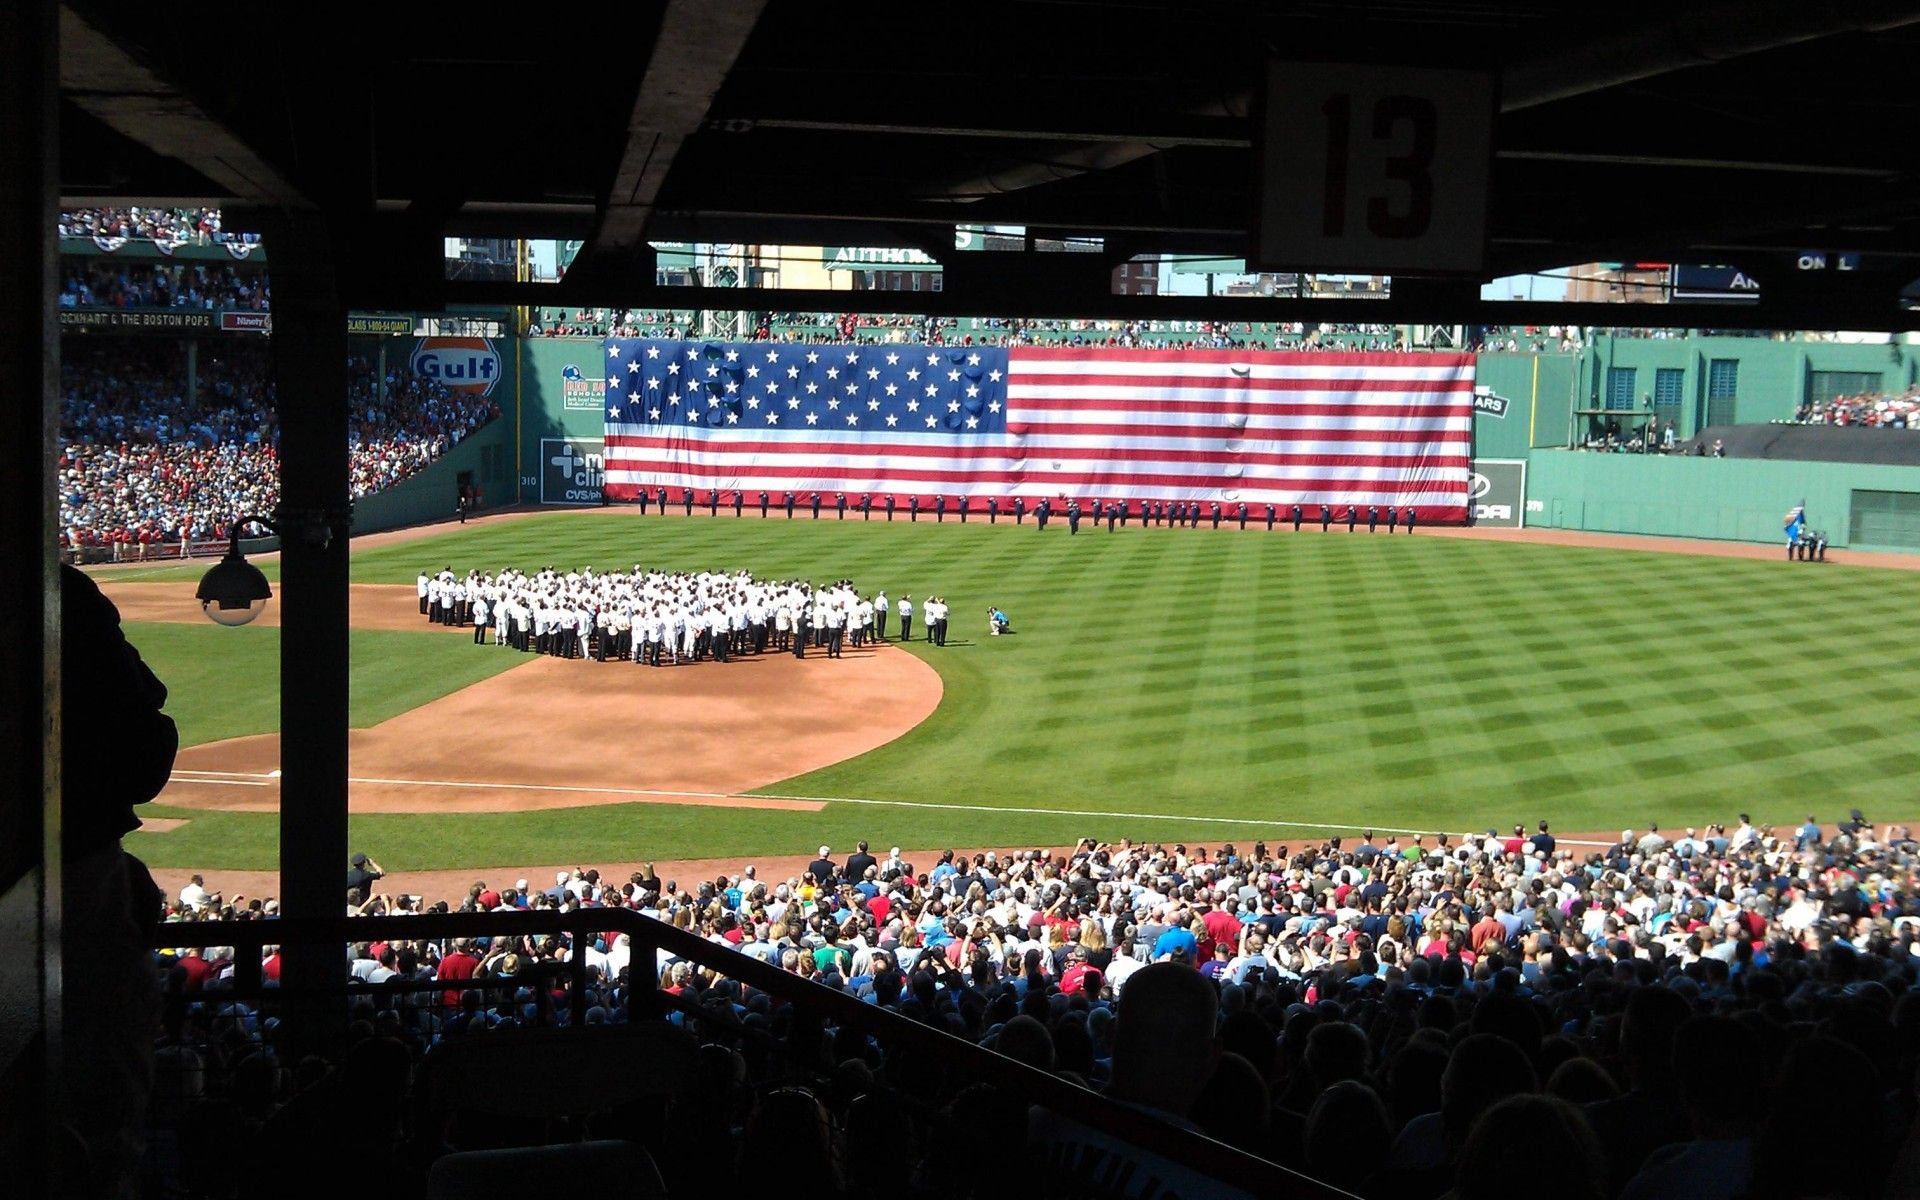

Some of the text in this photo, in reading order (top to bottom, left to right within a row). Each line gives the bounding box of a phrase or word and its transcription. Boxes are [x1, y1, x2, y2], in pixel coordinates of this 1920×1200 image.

[1320, 93, 1437, 239] 13
[121, 313, 140, 325] THE
[143, 313, 182, 326] BOSTON
[185, 314, 210, 326] POPS
[416, 354, 494, 379] Gulf
[521, 477, 537, 486] 310
